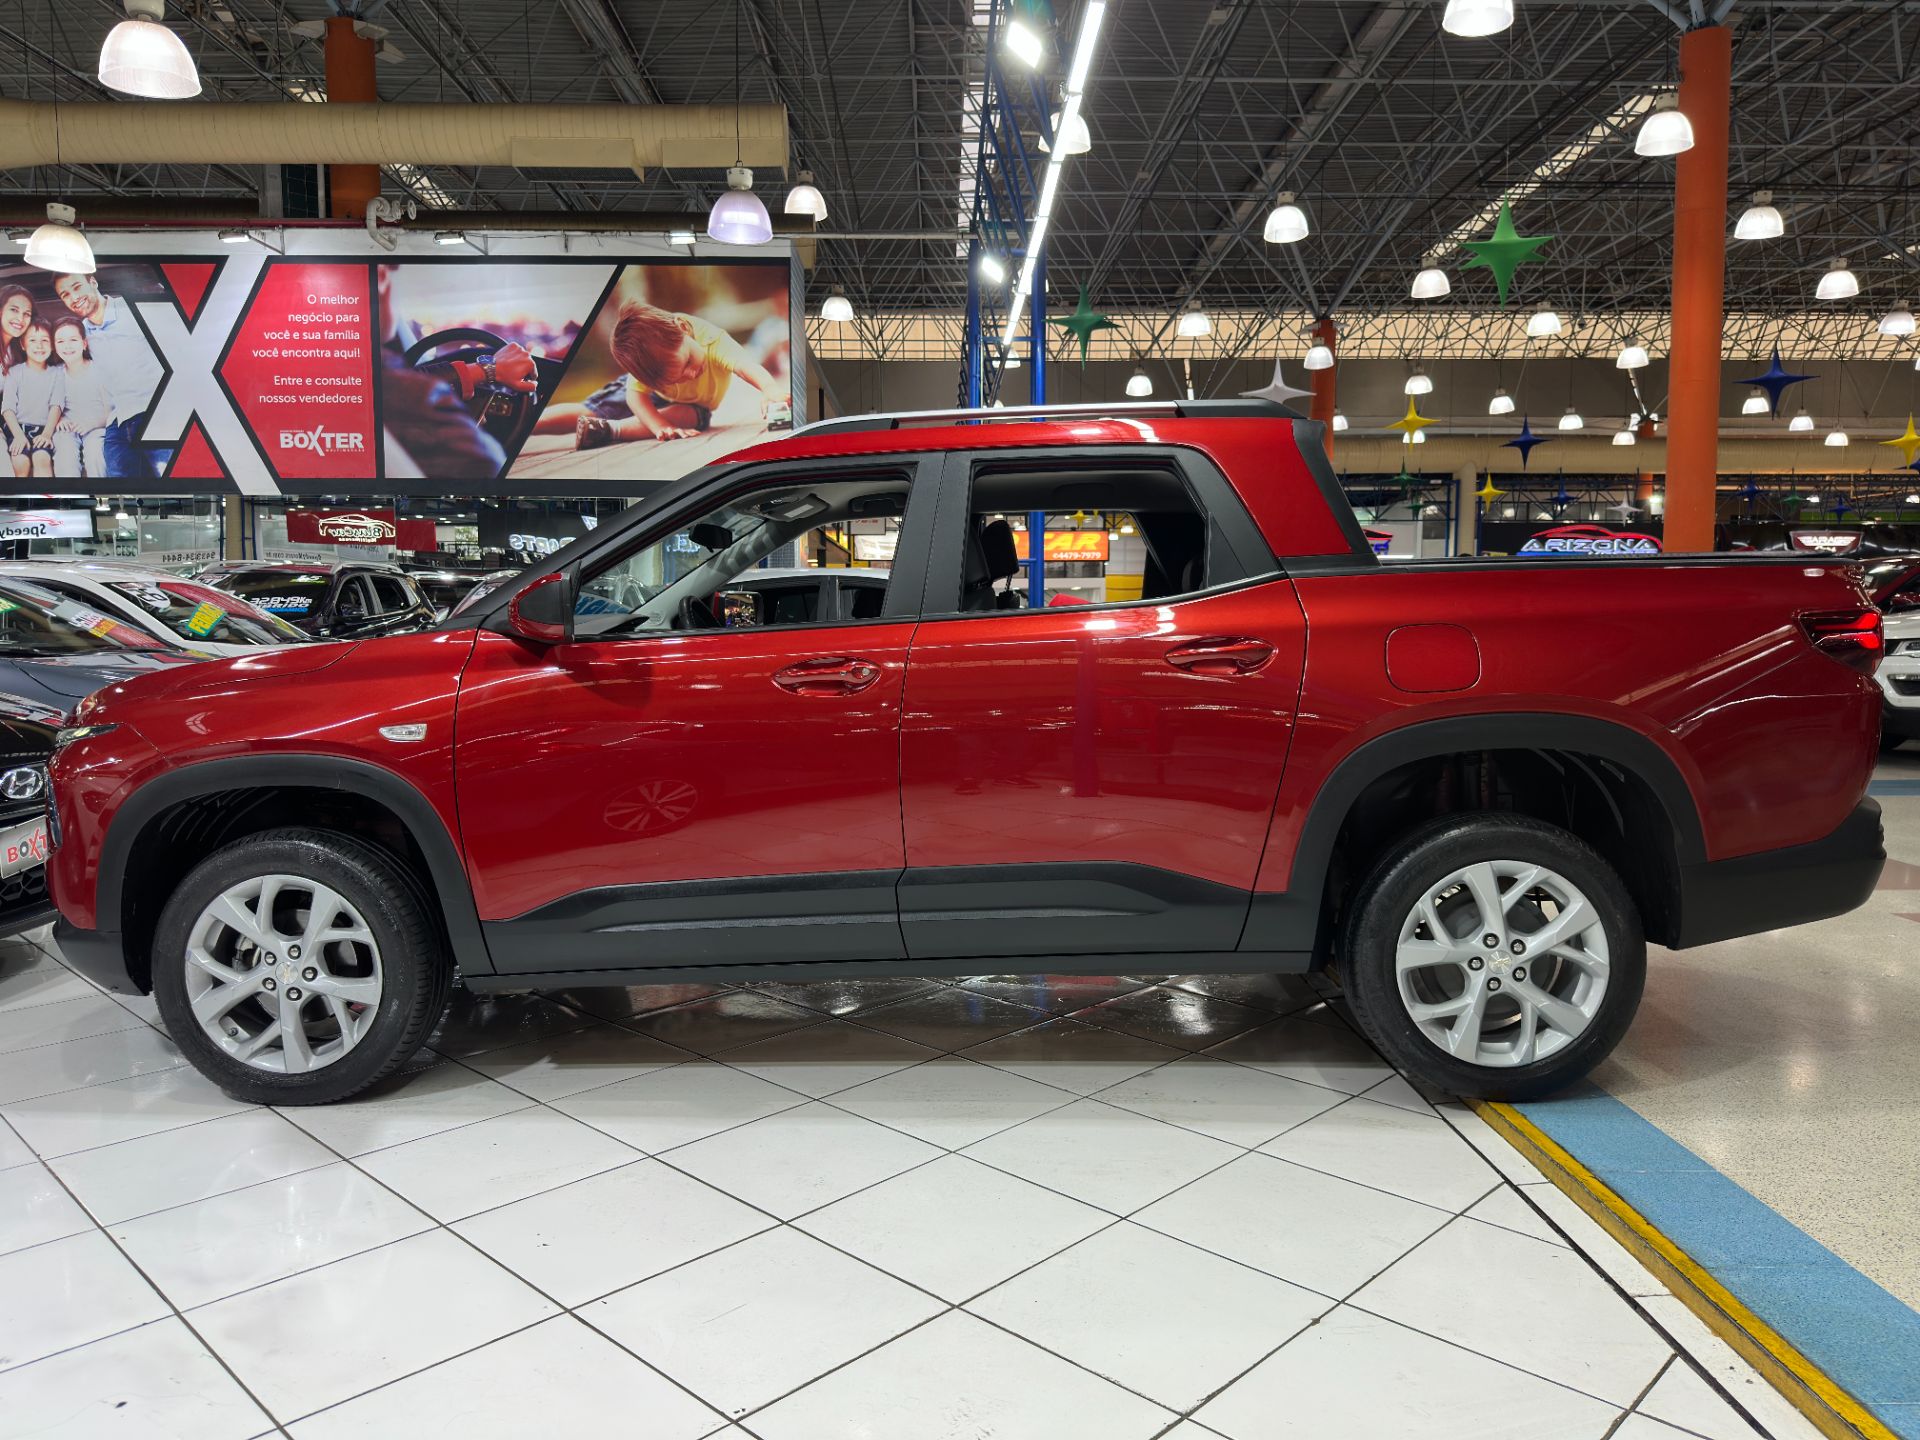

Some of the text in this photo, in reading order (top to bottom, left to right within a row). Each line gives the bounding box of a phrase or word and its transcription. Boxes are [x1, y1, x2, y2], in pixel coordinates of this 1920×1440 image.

[307, 294, 360, 304] O melhor
[288, 312, 360, 325] negócio para
[264, 330, 360, 340] você e sua família
[252, 348, 361, 359] você encontra aqui!
[274, 376, 362, 386] Entre e consulte
[259, 393, 363, 404] nossos vendedores
[280, 425, 364, 457] BOXTER
[1520, 538, 1658, 552] ARIZONA
